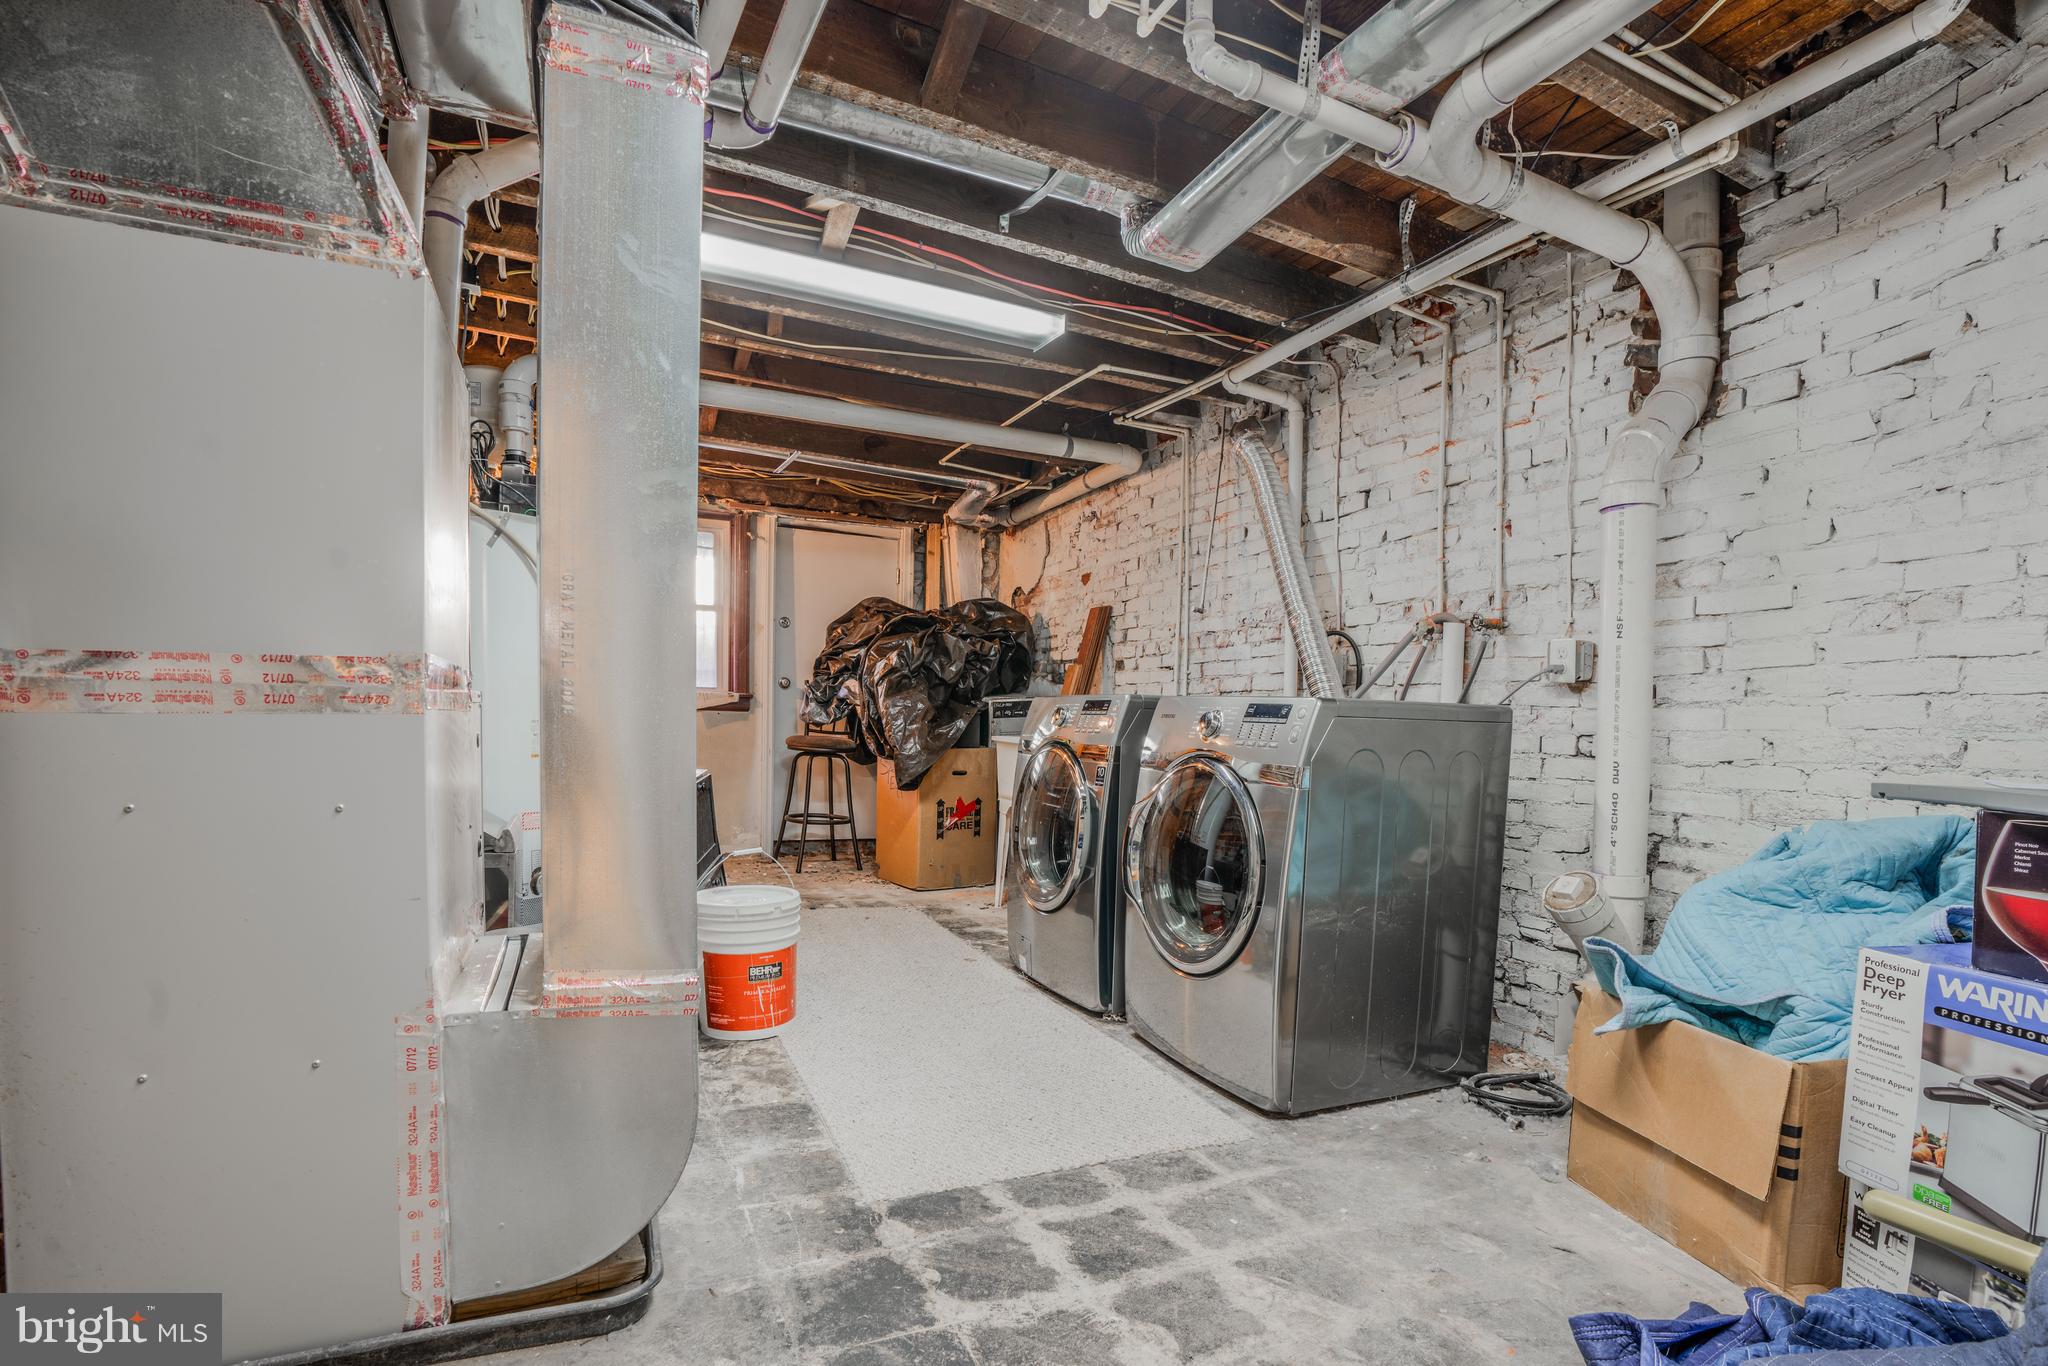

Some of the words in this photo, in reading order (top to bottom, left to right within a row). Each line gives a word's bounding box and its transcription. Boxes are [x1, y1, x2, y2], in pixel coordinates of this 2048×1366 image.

[69, 188, 107, 205] 07/12
[177, 207, 214, 223] 324A
[1616, 615, 1624, 639] NSF
[560, 620, 575, 669] METAL
[149, 651, 210, 663] Nashua
[261, 654, 293, 663] 07/12
[106, 670, 141, 681] 324A
[150, 672, 212, 684] Nashua
[262, 673, 294, 684] 07/12
[108, 692, 142, 703] 324A
[152, 692, 214, 705] Nashua
[264, 694, 295, 704] 07/12
[1097, 768, 1105, 777] 10
[750, 965, 773, 976] BEHR
[1864, 956, 1920, 977] Professional
[1864, 966, 1906, 990] Deep
[556, 996, 603, 1004] Nashua
[609, 996, 636, 1005] 324A
[684, 994, 698, 1002] 07/
[1862, 979, 1906, 1000] Fryer
[1938, 974, 2048, 1024] WARIN
[609, 1008, 634, 1017] 324A
[684, 1008, 698, 1016] 07/
[1860, 1000, 1884, 1012] Sturdy
[1860, 1008, 1906, 1025] Construction
[1941, 1008, 2048, 1044] PROFESSION
[1857, 1040, 1903, 1060] Performance
[1858, 1032, 1900, 1050] Professional
[406, 1047, 417, 1072] 07/12
[428, 1045, 439, 1070] 07/12
[1854, 1068, 1886, 1084] Compact
[1888, 1079, 1913, 1093] Appeal
[1852, 1096, 1875, 1108] Digital
[1877, 1104, 1900, 1117] Timer
[408, 1120, 418, 1146] 324A
[1850, 1116, 1866, 1127] Easy
[1867, 1122, 1897, 1139] Cleanup
[407, 1152, 417, 1197] Nashua
[429, 1150, 439, 1194] Nashua
[1855, 1232, 1875, 1245] Storage
[1850, 1243, 1878, 1262] Restaurant
[1879, 1260, 1900, 1276] Quality
[411, 1267, 422, 1292] 324A
[434, 1264, 444, 1288] 324A
